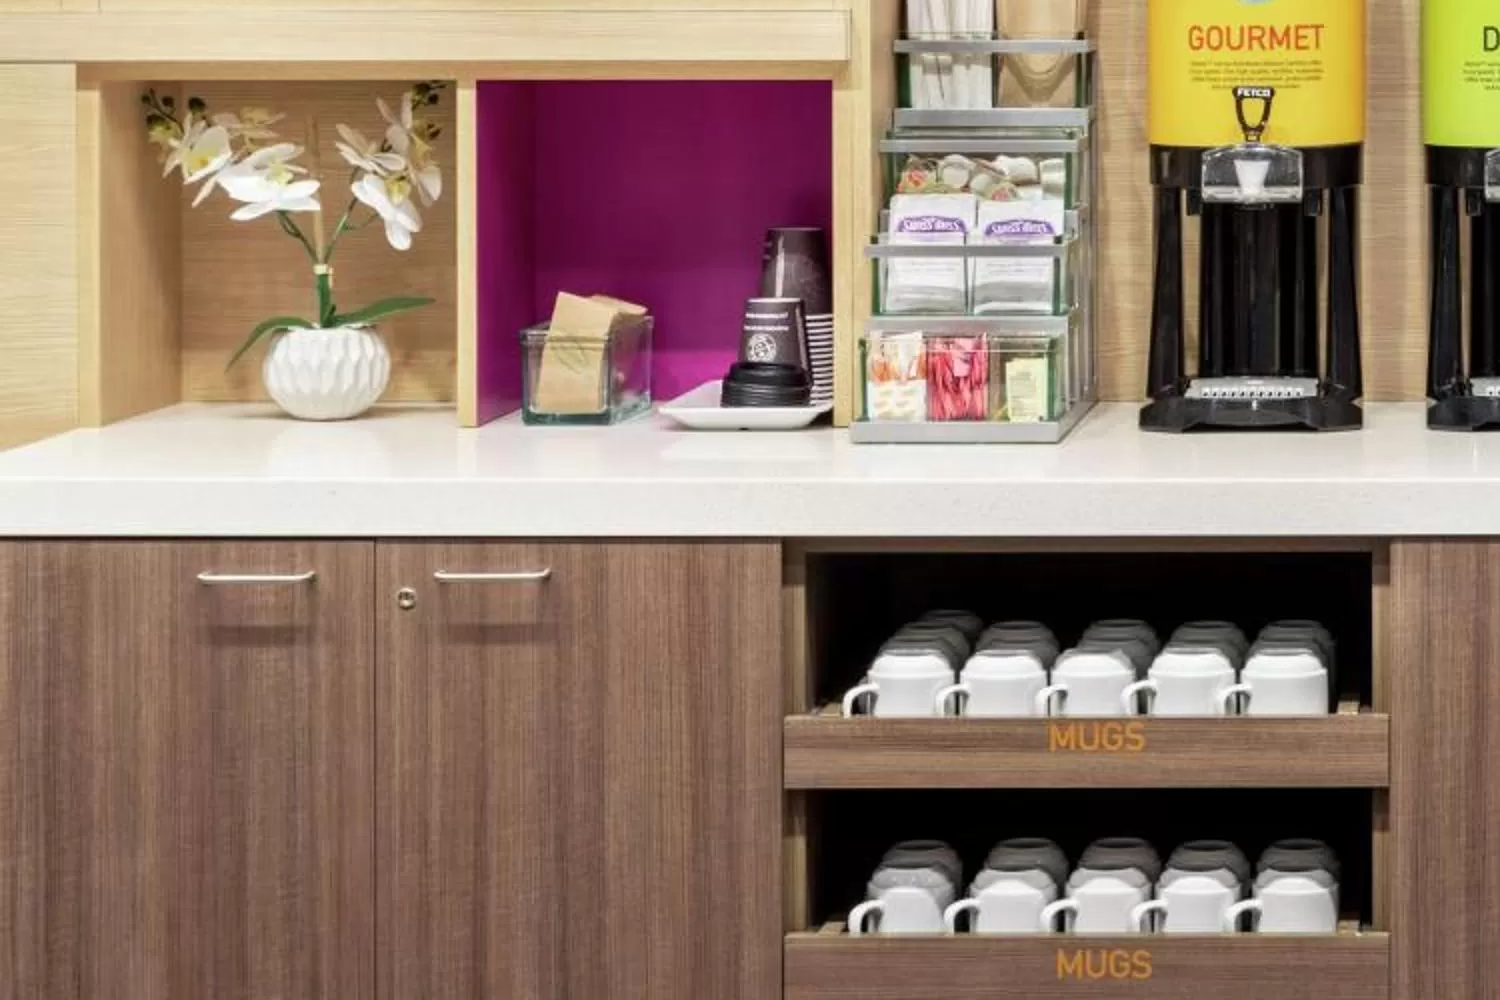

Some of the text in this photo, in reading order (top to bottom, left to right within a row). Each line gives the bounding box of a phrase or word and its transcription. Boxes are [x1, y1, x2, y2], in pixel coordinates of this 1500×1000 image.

[1187, 23, 1325, 52] GOURMET
[1048, 720, 1147, 752] MUGS
[1056, 947, 1153, 980] MUGS
